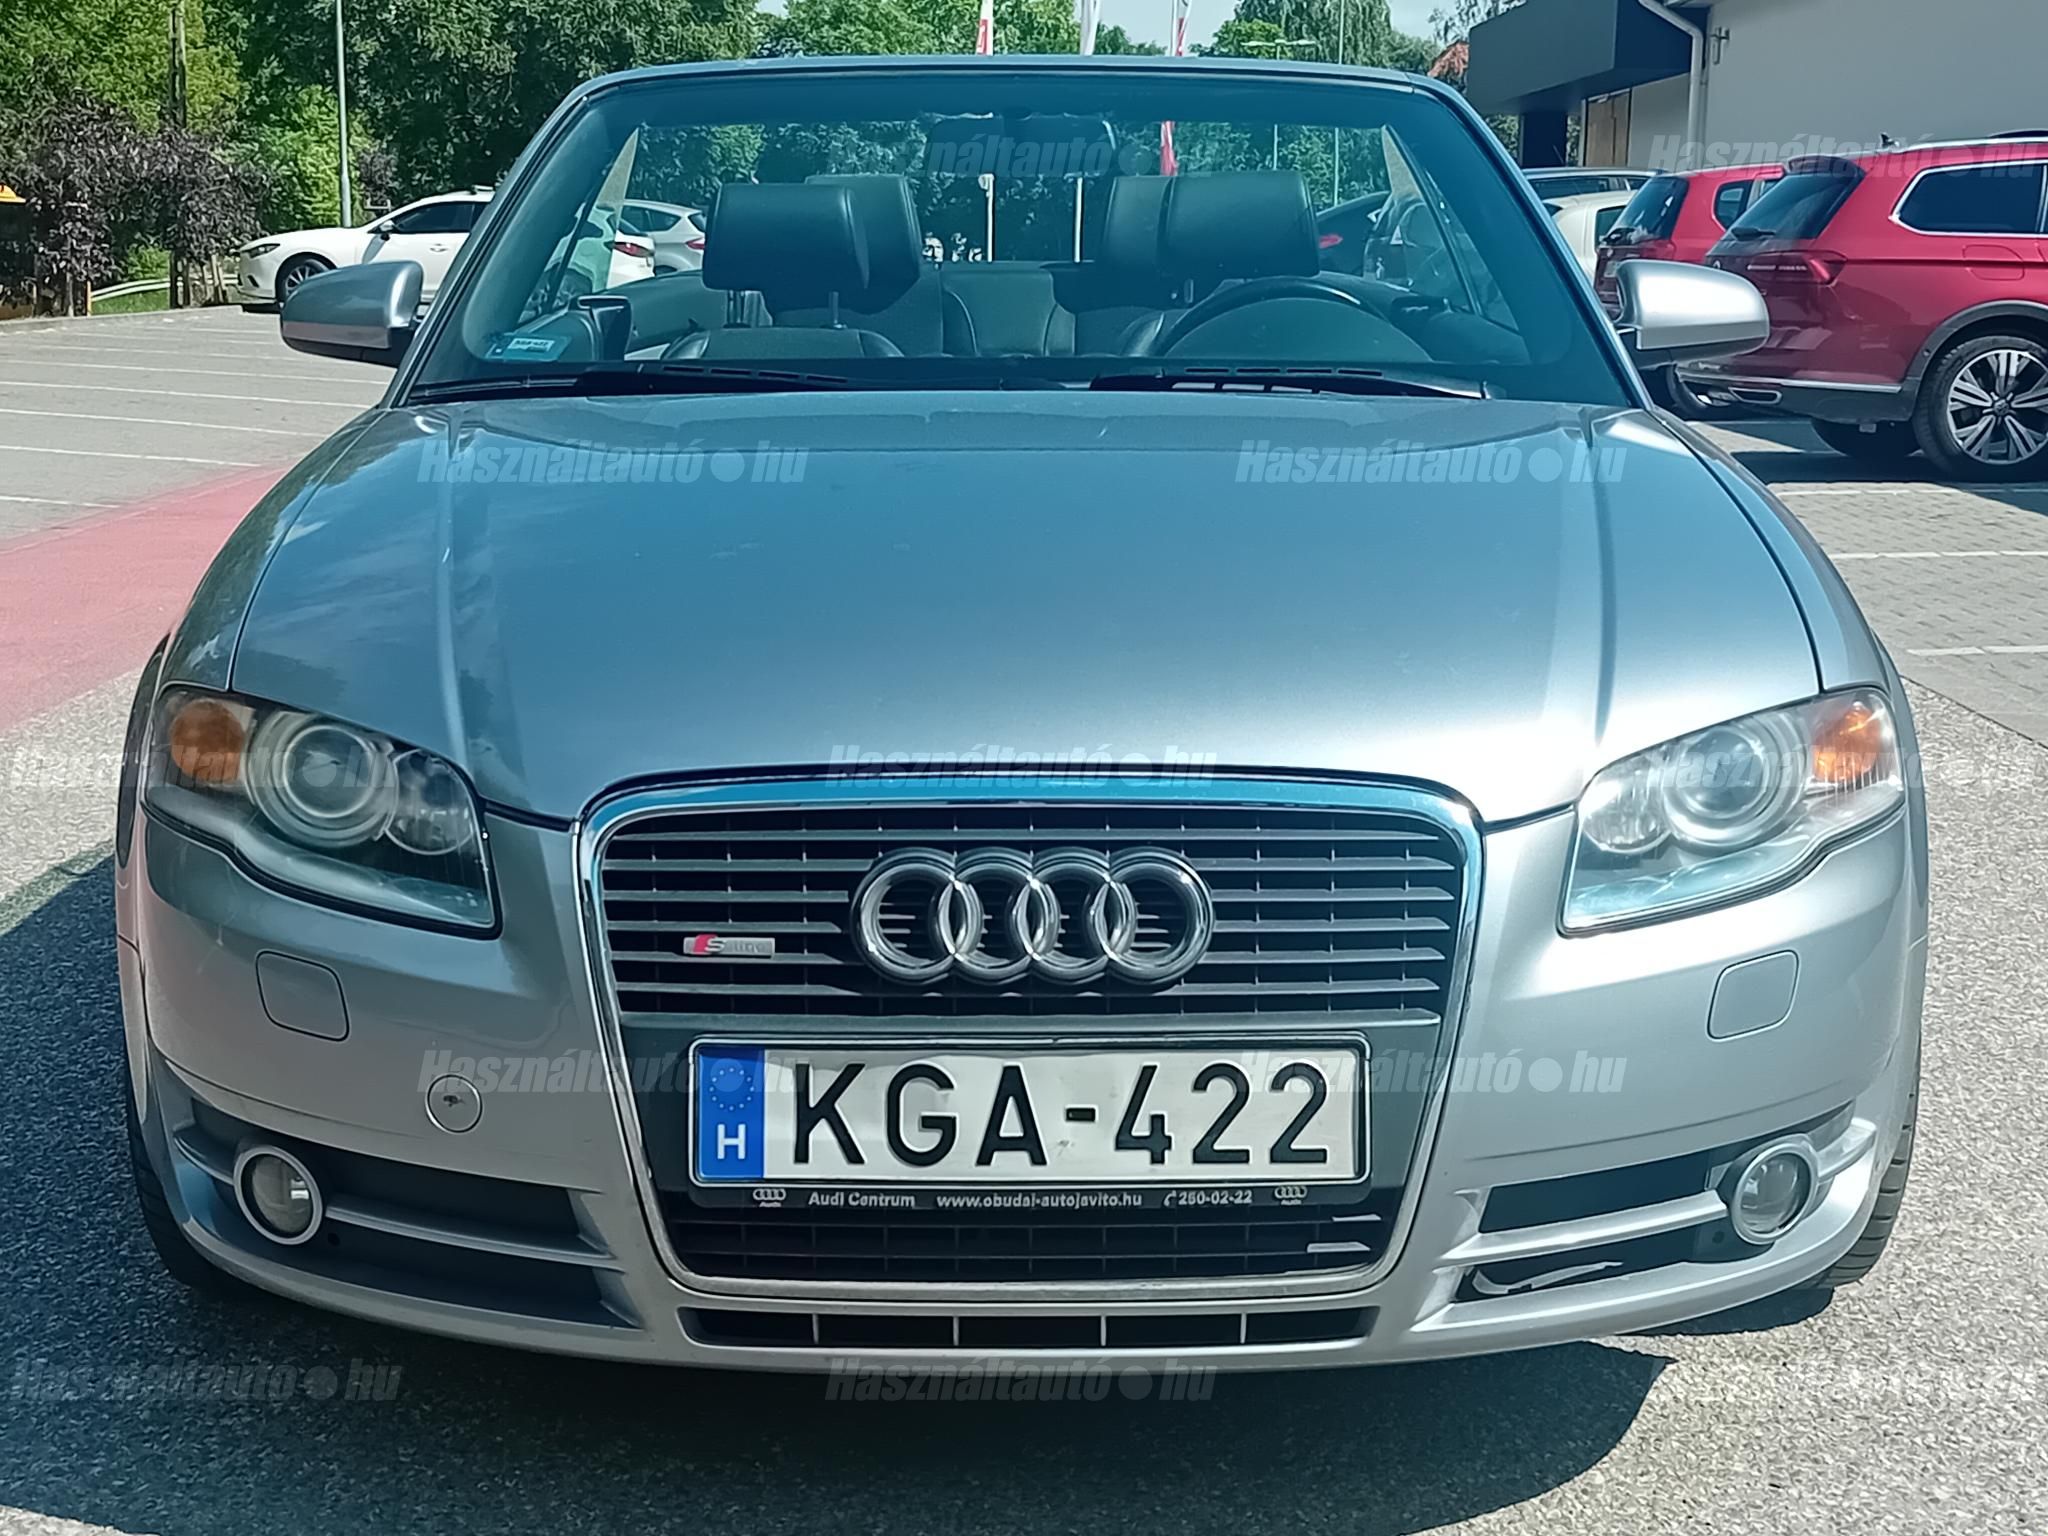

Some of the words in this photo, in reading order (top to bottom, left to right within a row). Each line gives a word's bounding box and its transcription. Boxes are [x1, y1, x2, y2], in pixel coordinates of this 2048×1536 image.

[793, 1061, 1329, 1168] KGA-422
[717, 1123, 746, 1160] H
[808, 1191, 845, 1207] Audi
[848, 1191, 915, 1207] Centrum
